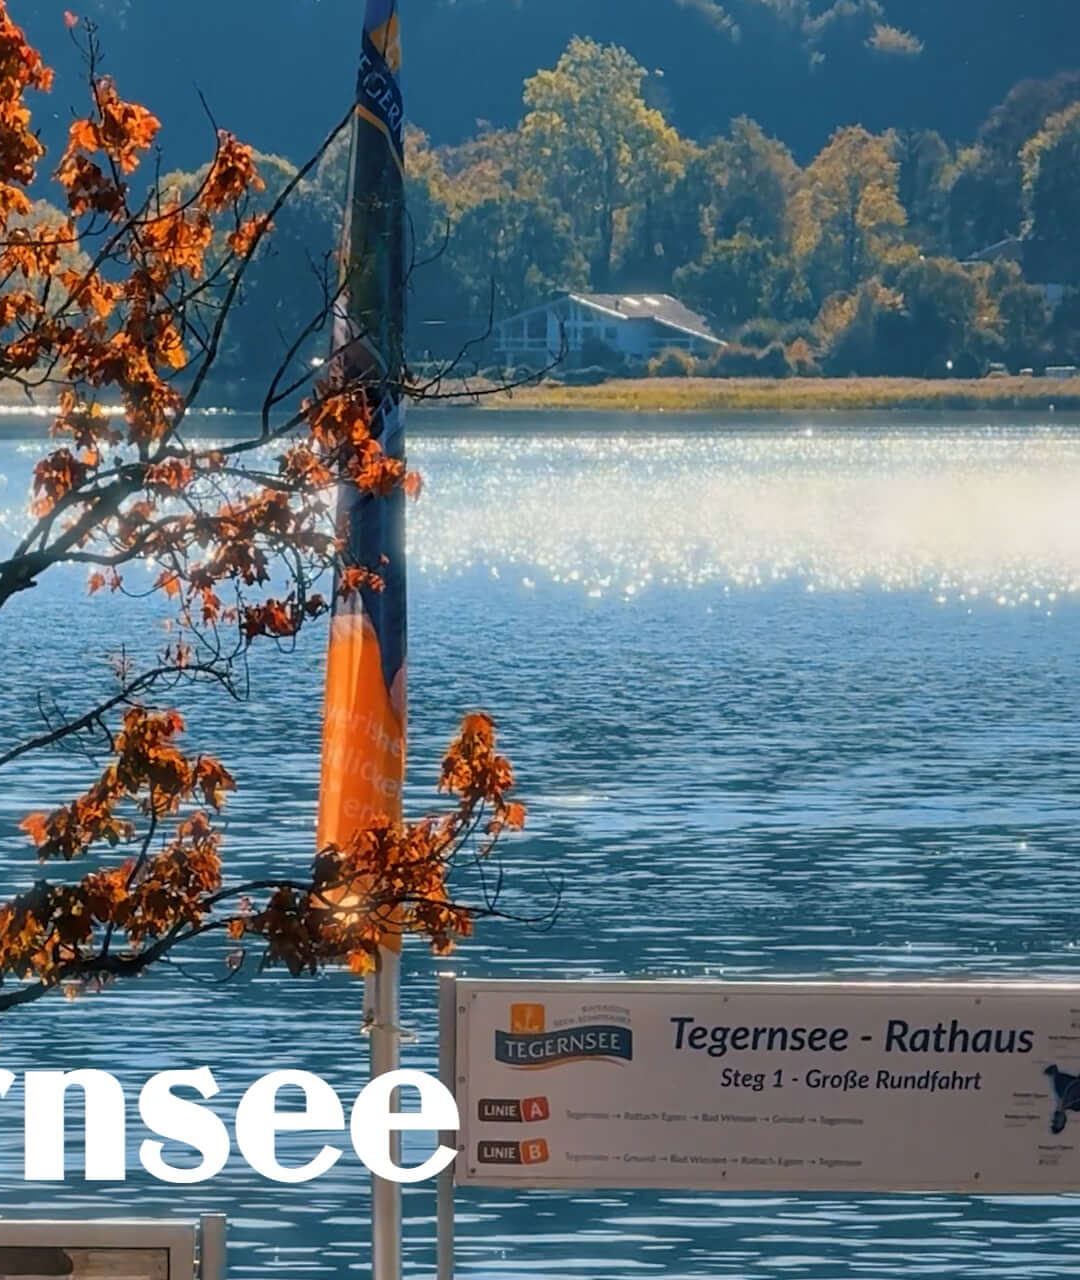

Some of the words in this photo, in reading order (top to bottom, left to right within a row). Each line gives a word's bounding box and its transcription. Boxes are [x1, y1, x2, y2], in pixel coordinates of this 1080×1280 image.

[504, 1032, 622, 1059] TEGERNSEE
[669, 1016, 849, 1058] Tegernsee
[884, 1019, 1035, 1054] Rathaus
[720, 1067, 767, 1092] Steg
[772, 1068, 784, 1089] 1
[805, 1068, 870, 1092] Große
[875, 1069, 983, 1093] Rundfahrt
[483, 1104, 517, 1117] LINIE
[529, 1102, 544, 1118] A
[482, 1146, 517, 1159] LINIE
[528, 1144, 542, 1160] B
